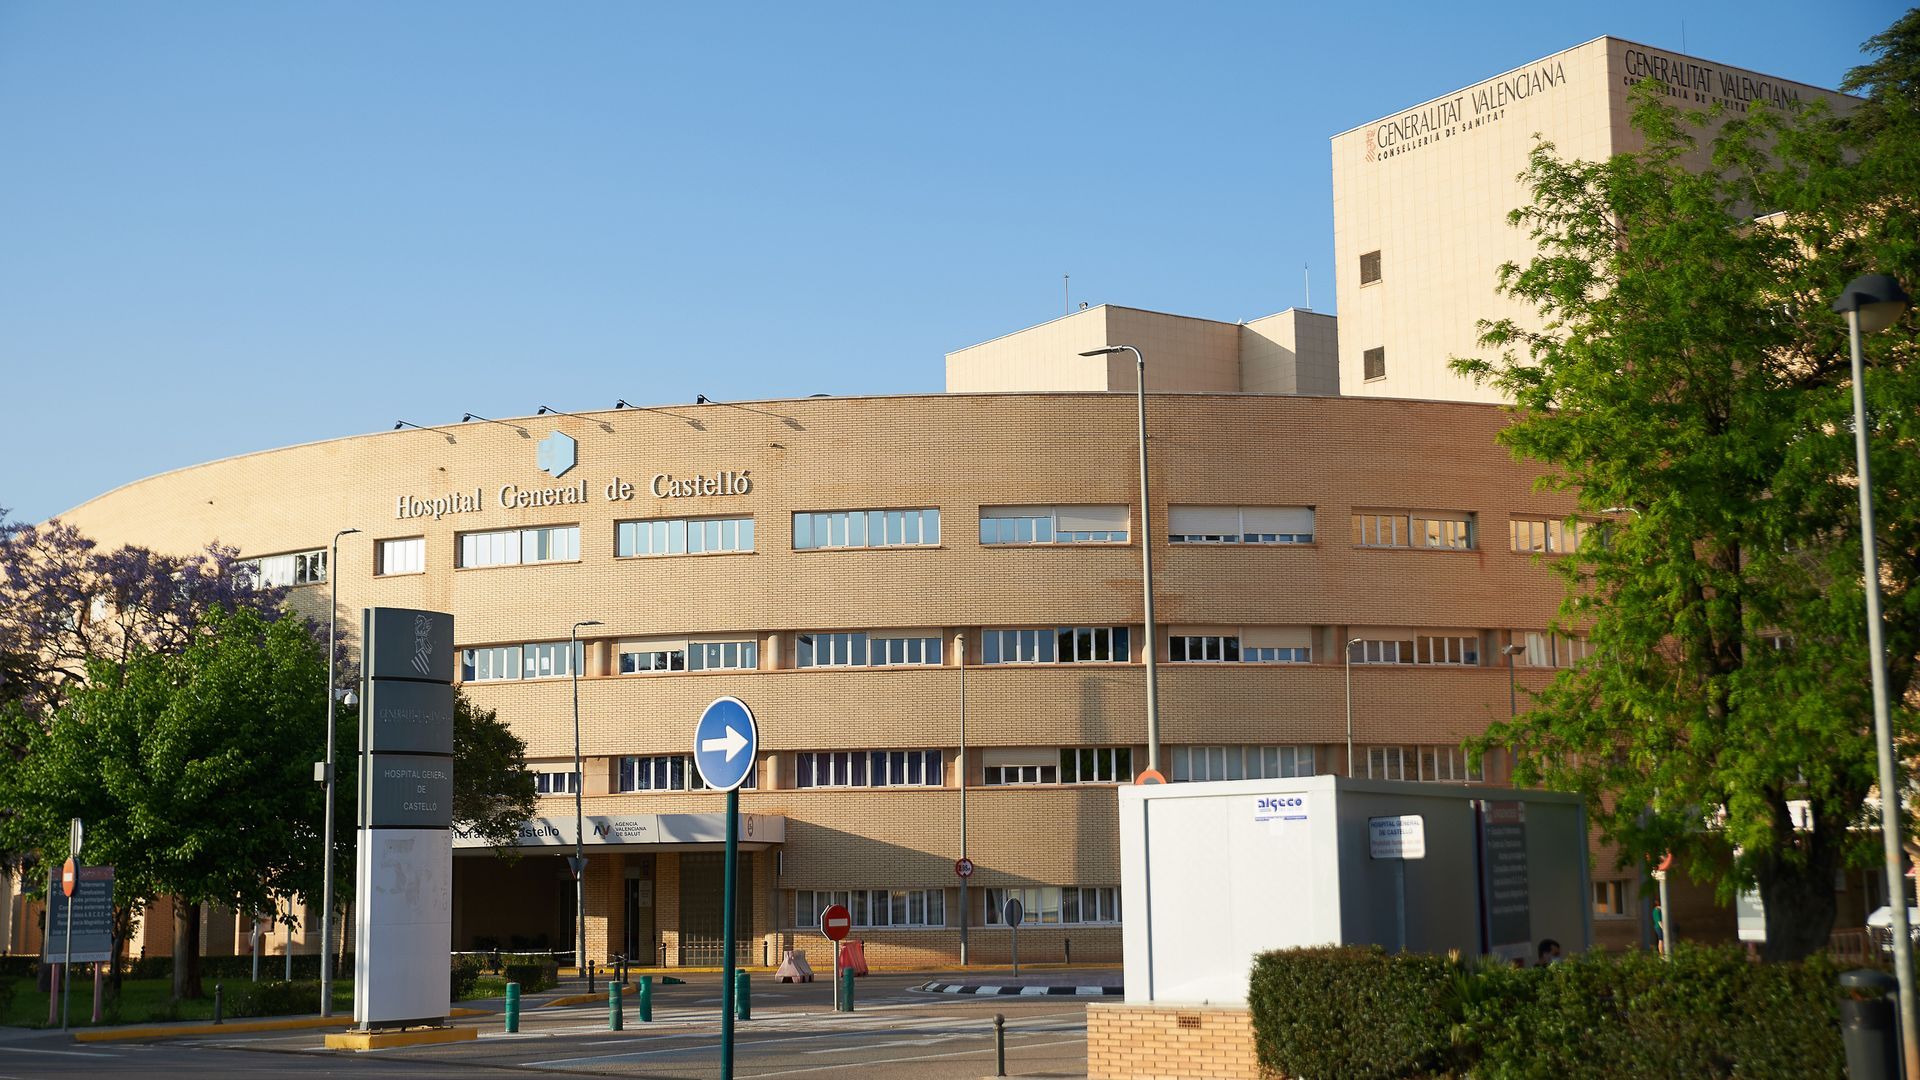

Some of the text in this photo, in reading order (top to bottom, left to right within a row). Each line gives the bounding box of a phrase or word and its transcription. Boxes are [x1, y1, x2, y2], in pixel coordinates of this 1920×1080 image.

[1625, 49, 1712, 94] GENERALITAT
[1377, 61, 1566, 149] GENERALITAT VALENCIANA
[1377, 109, 1505, 161] CONSELLERIA DE SANITAT
[395, 470, 753, 521] Hospital General de Castelló
[384, 769, 421, 779] HOSPITAL
[417, 785, 427, 794] DE
